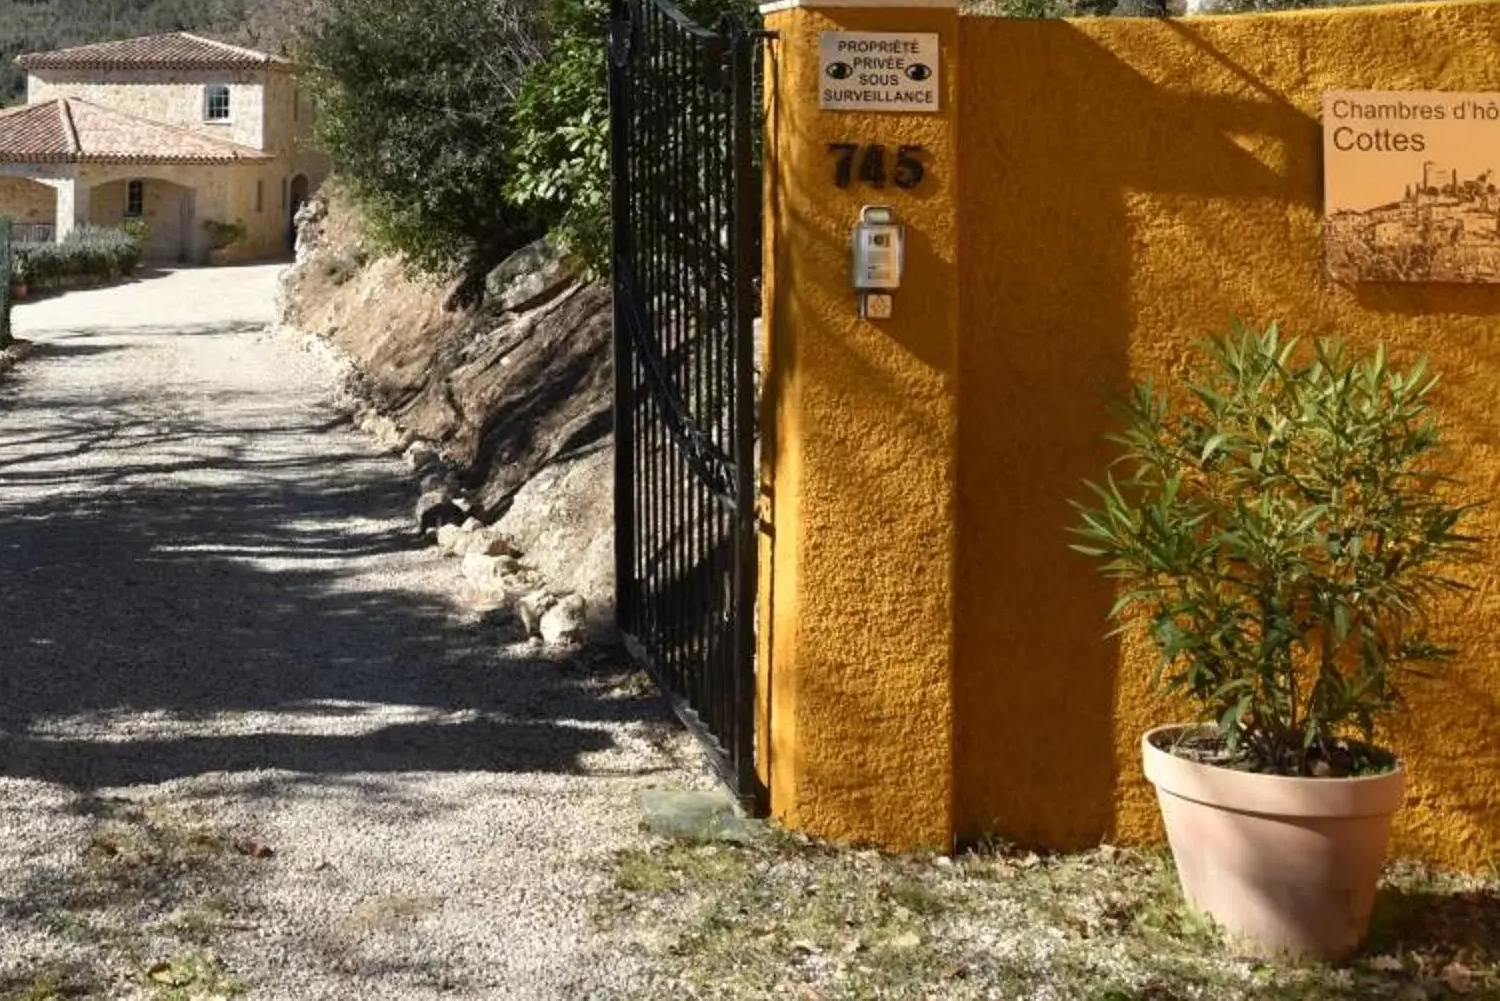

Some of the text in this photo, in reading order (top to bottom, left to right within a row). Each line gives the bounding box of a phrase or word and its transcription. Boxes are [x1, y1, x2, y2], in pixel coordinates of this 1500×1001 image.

[837, 38, 920, 54] PROPRIÉTÉ
[853, 55, 905, 70] PRIVÉE
[859, 73, 899, 86] SOUS
[823, 89, 933, 104] SURVEILLANCE
[1332, 99, 1446, 120] Chambres
[1333, 126, 1426, 152] Cottes
[826, 143, 925, 190] 745
